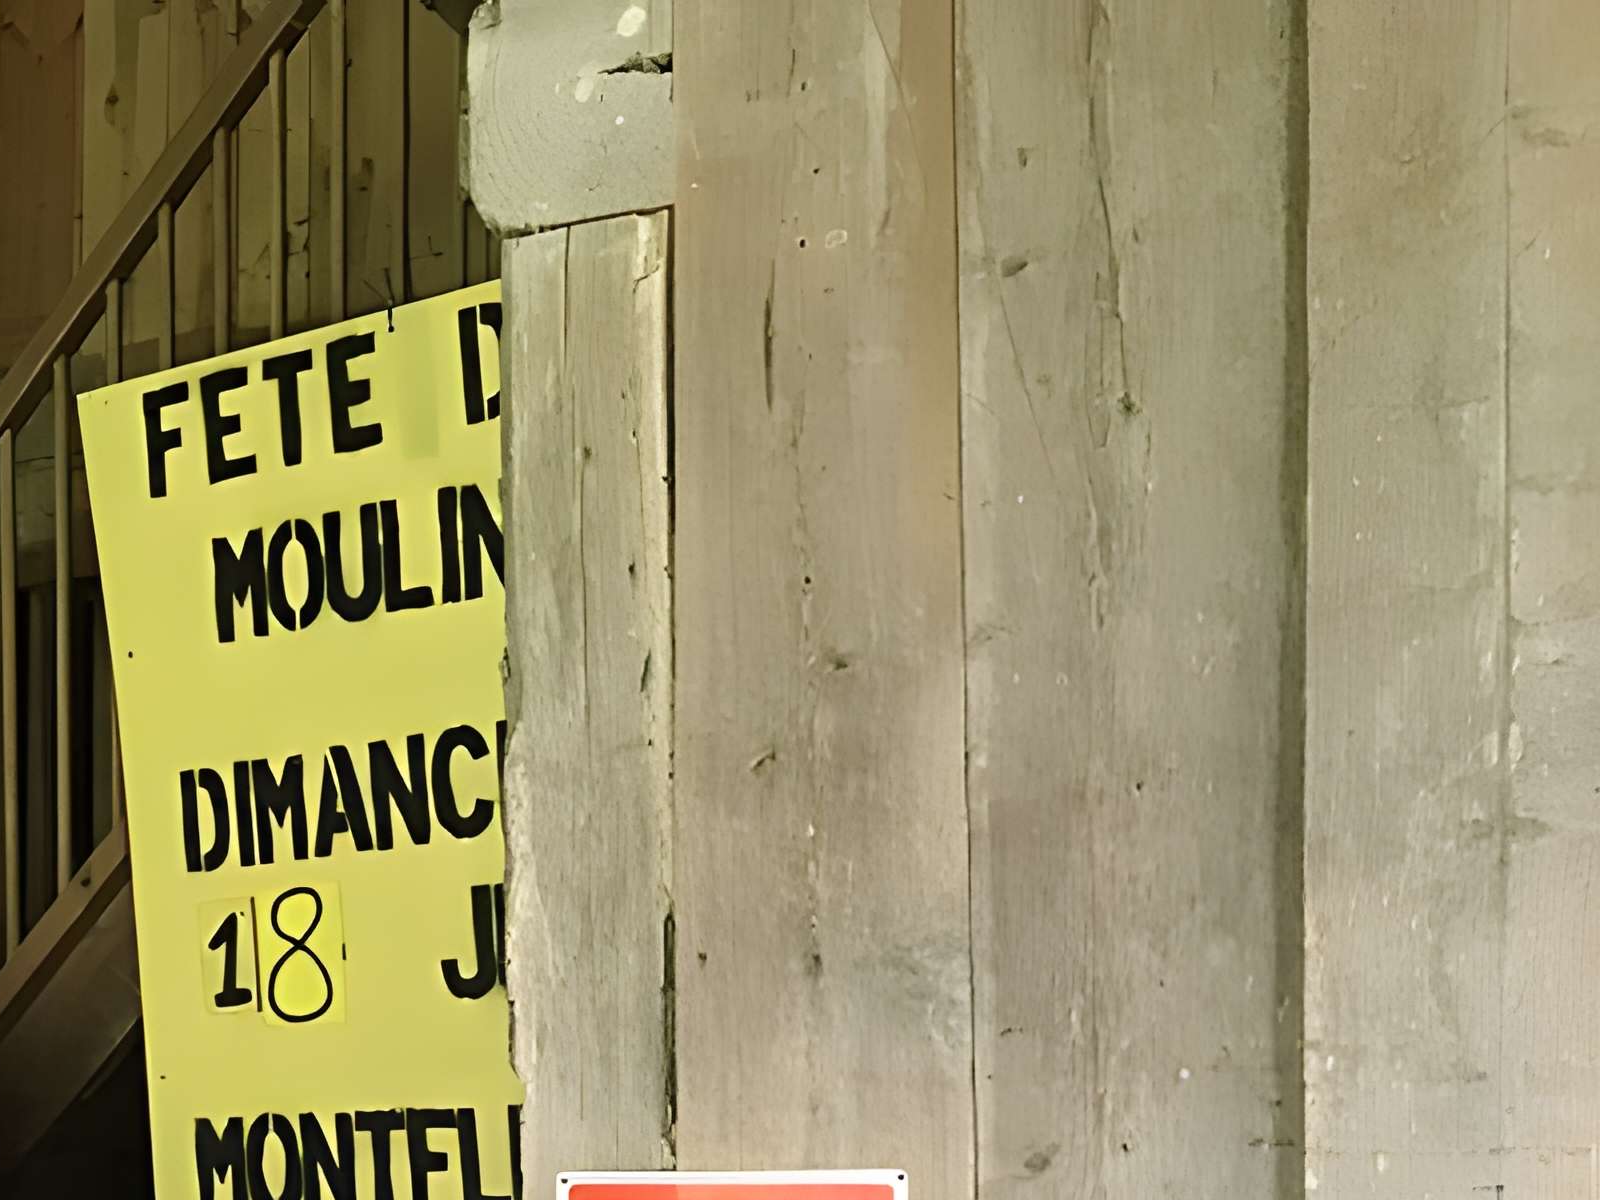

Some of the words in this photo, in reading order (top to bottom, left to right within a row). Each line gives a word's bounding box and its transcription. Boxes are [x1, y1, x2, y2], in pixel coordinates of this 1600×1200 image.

[142, 330, 384, 499] FETE
[179, 719, 507, 873] DIMANC
[208, 886, 334, 1023] 18
[441, 883, 508, 1001] J
